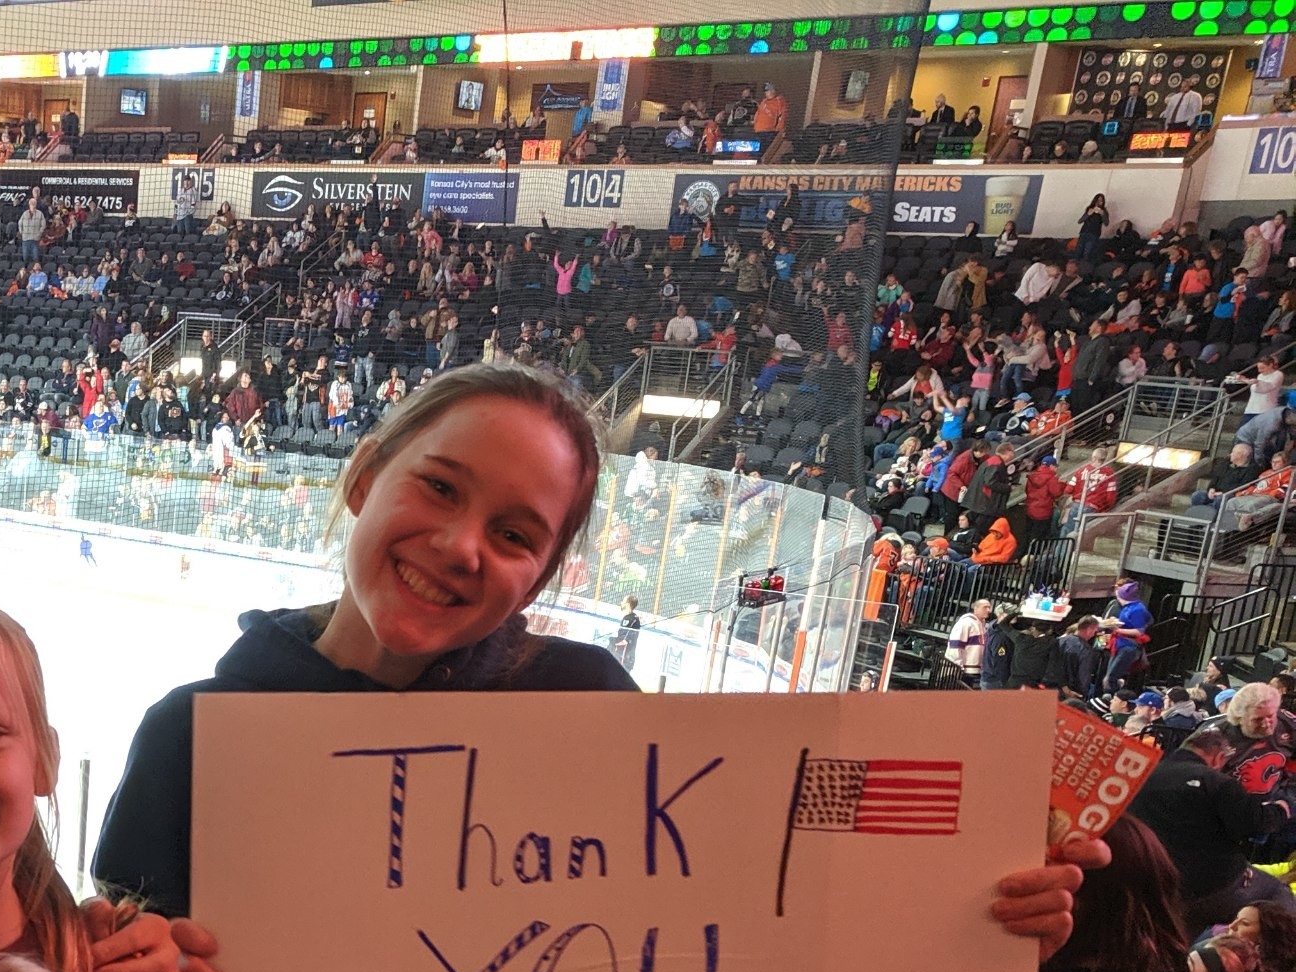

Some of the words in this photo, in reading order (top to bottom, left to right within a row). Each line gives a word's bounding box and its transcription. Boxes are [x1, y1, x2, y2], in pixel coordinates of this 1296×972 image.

[41, 176, 73, 185] COMMERCIAL
[78, 177, 108, 186] RESIDENTIAL
[109, 177, 134, 186] SERVICES
[430, 180, 454, 188] Kansas
[455, 180, 473, 190] City's
[473, 181, 491, 189] most
[570, 173, 621, 203] 104
[739, 175, 810, 191] KANSAS
[812, 176, 854, 191] CITY
[855, 176, 962, 192] MAERICKS
[52, 195, 123, 210] 86.5247475
[1072, 724, 1095, 754] GET
[1099, 735, 1123, 766] BUY
[1052, 754, 1075, 786] ONE
[1067, 734, 1105, 786] COMBO
[1075, 768, 1101, 799] ONE
